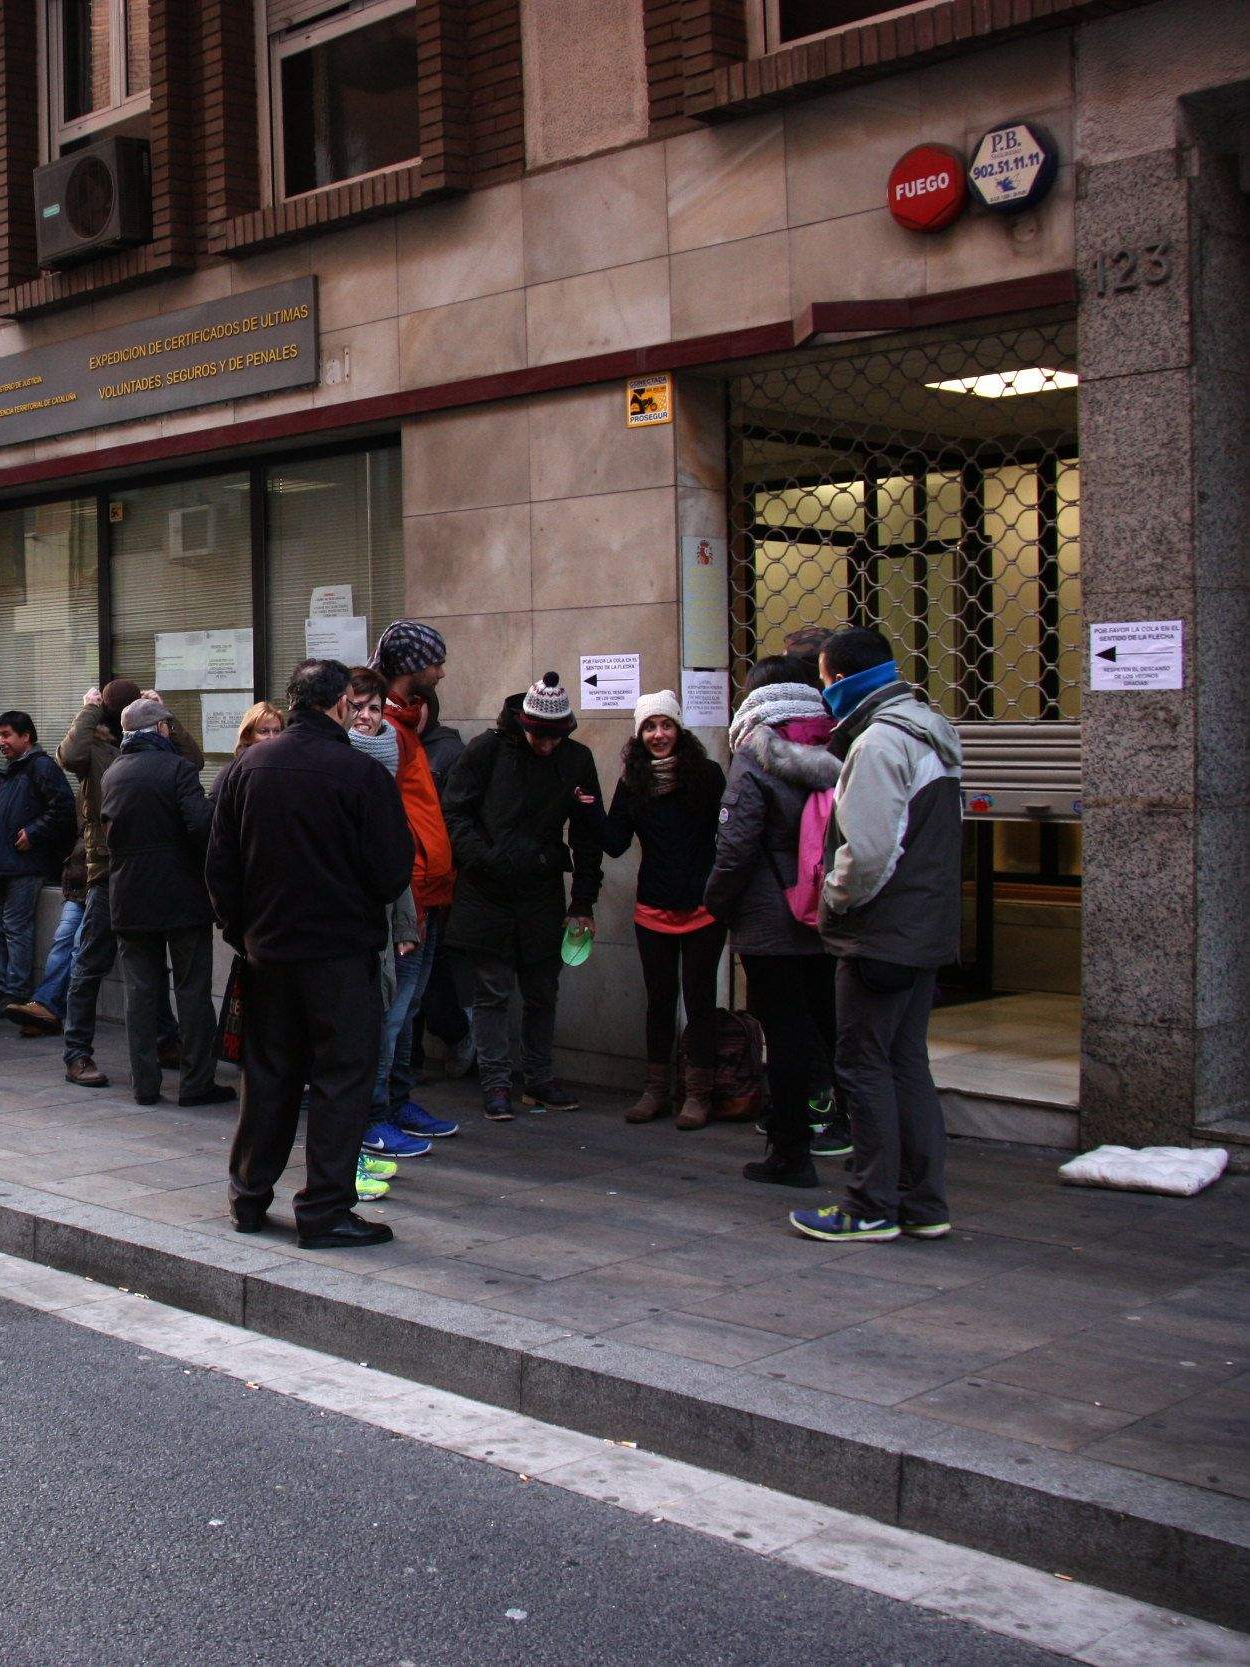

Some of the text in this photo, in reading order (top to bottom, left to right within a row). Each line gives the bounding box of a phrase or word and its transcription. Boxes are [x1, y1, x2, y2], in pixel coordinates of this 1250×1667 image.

[990, 131, 1022, 154] P.B.
[973, 151, 1040, 181] 902.51.11.11
[895, 172, 950, 201] FUEGO
[1094, 241, 1173, 298] 123
[89, 304, 309, 371] EXPEDICION DE CERTIFICADOS DE ULTIMAS
[166, 363, 217, 385] SEGUROS
[218, 360, 226, 374] Y
[228, 356, 245, 372] DE
[246, 343, 298, 367] PENALES
[15, 379, 22, 390] DE
[22, 376, 44, 388] JUSTICIA
[14, 402, 44, 414] TERRITORIAL
[44, 398, 52, 408] DE
[630, 410, 668, 423] PROSEGUR
[1109, 626, 1130, 634] FAVOR
